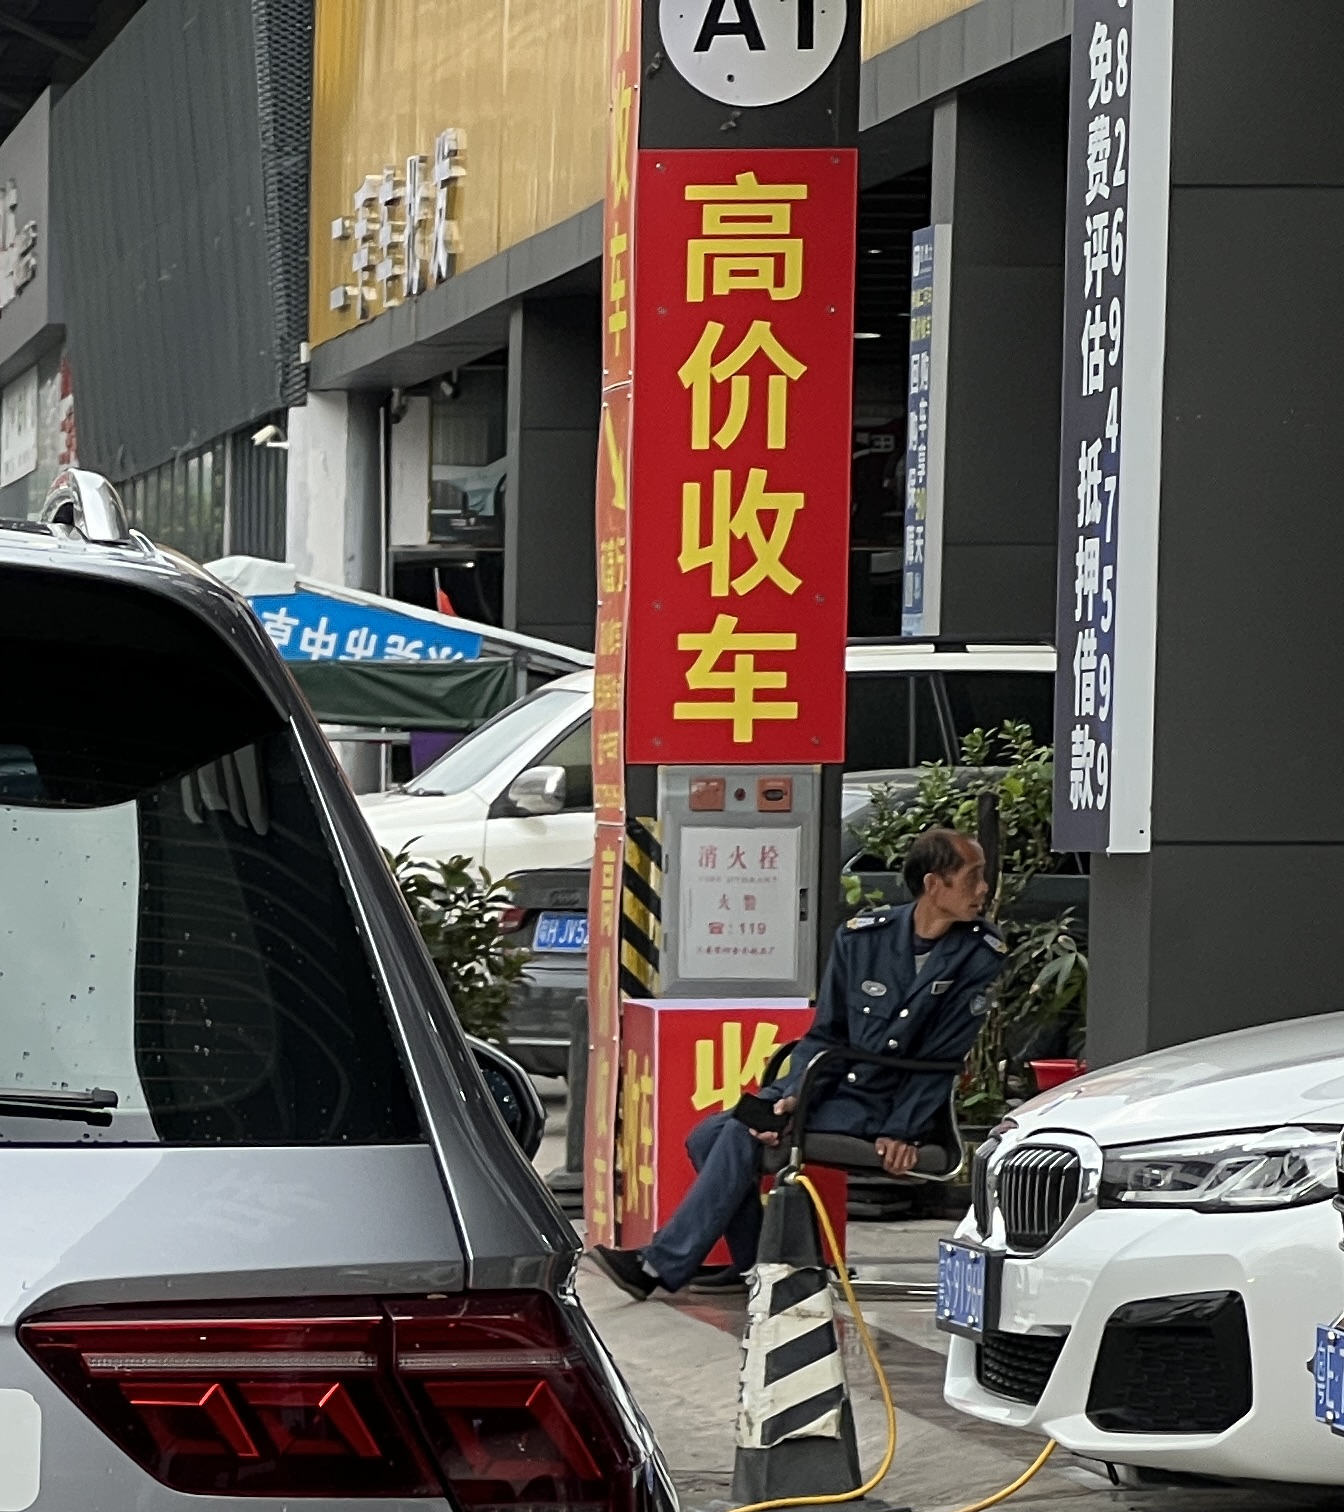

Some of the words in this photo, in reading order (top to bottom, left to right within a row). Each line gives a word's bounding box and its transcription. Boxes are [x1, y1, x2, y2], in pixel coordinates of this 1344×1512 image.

[1081, 21, 1113, 396] 免费评估
[673, 172, 808, 743] 高价收车
[1097, 0, 1128, 811] 826947599
[1070, 438, 1103, 811] 抵押借款
[698, 845, 779, 870] 消火栓
[740, 922, 767, 935] 119
